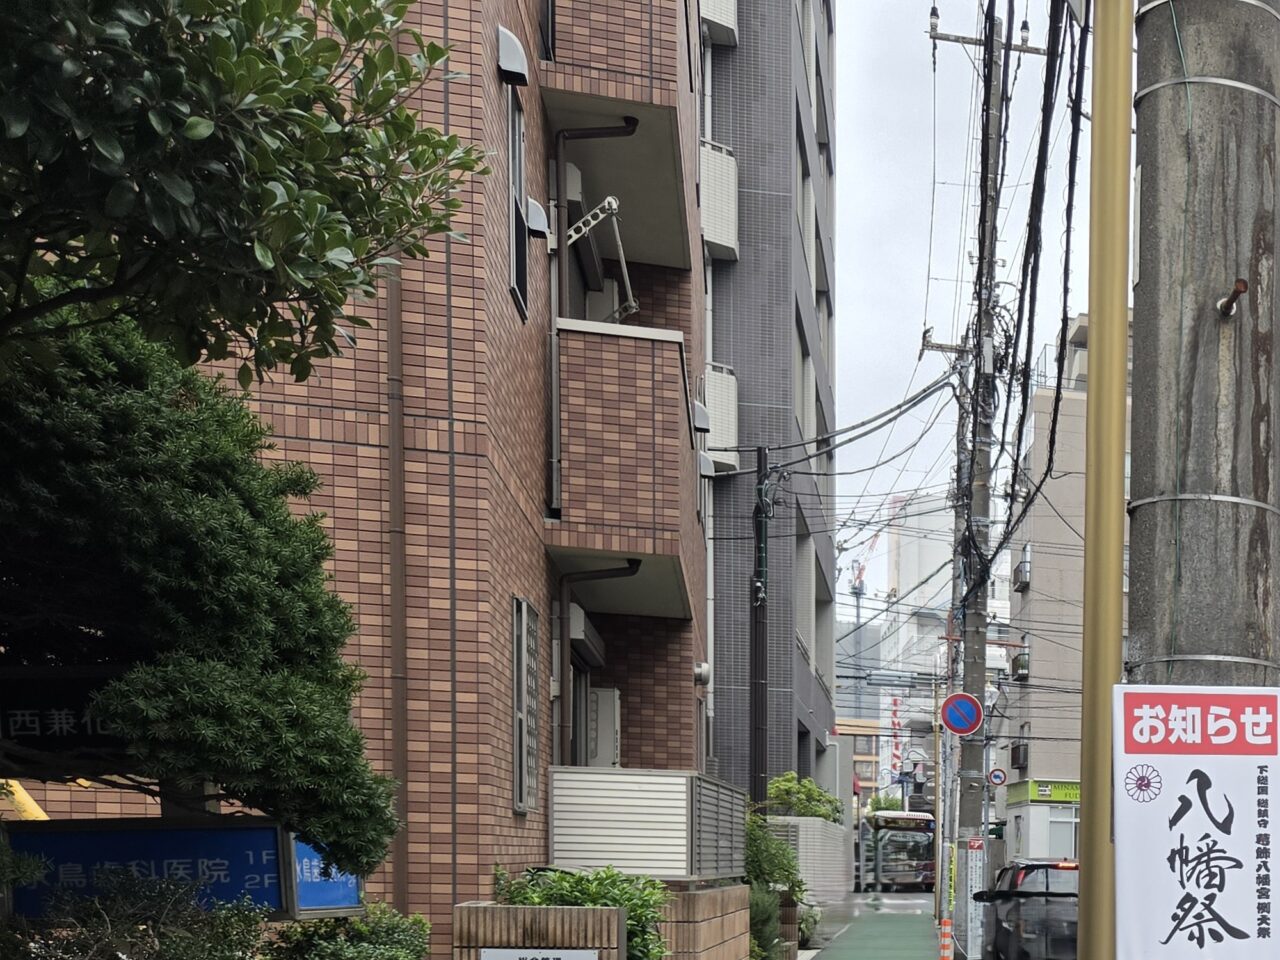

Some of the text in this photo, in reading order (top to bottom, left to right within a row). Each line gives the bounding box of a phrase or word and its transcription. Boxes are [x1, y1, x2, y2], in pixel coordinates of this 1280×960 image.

[1132, 704, 1273, 745] お知らせ
[244, 849, 277, 865] 1F
[1159, 768, 1251, 949] 八幡祭
[244, 873, 279, 889] 2F
